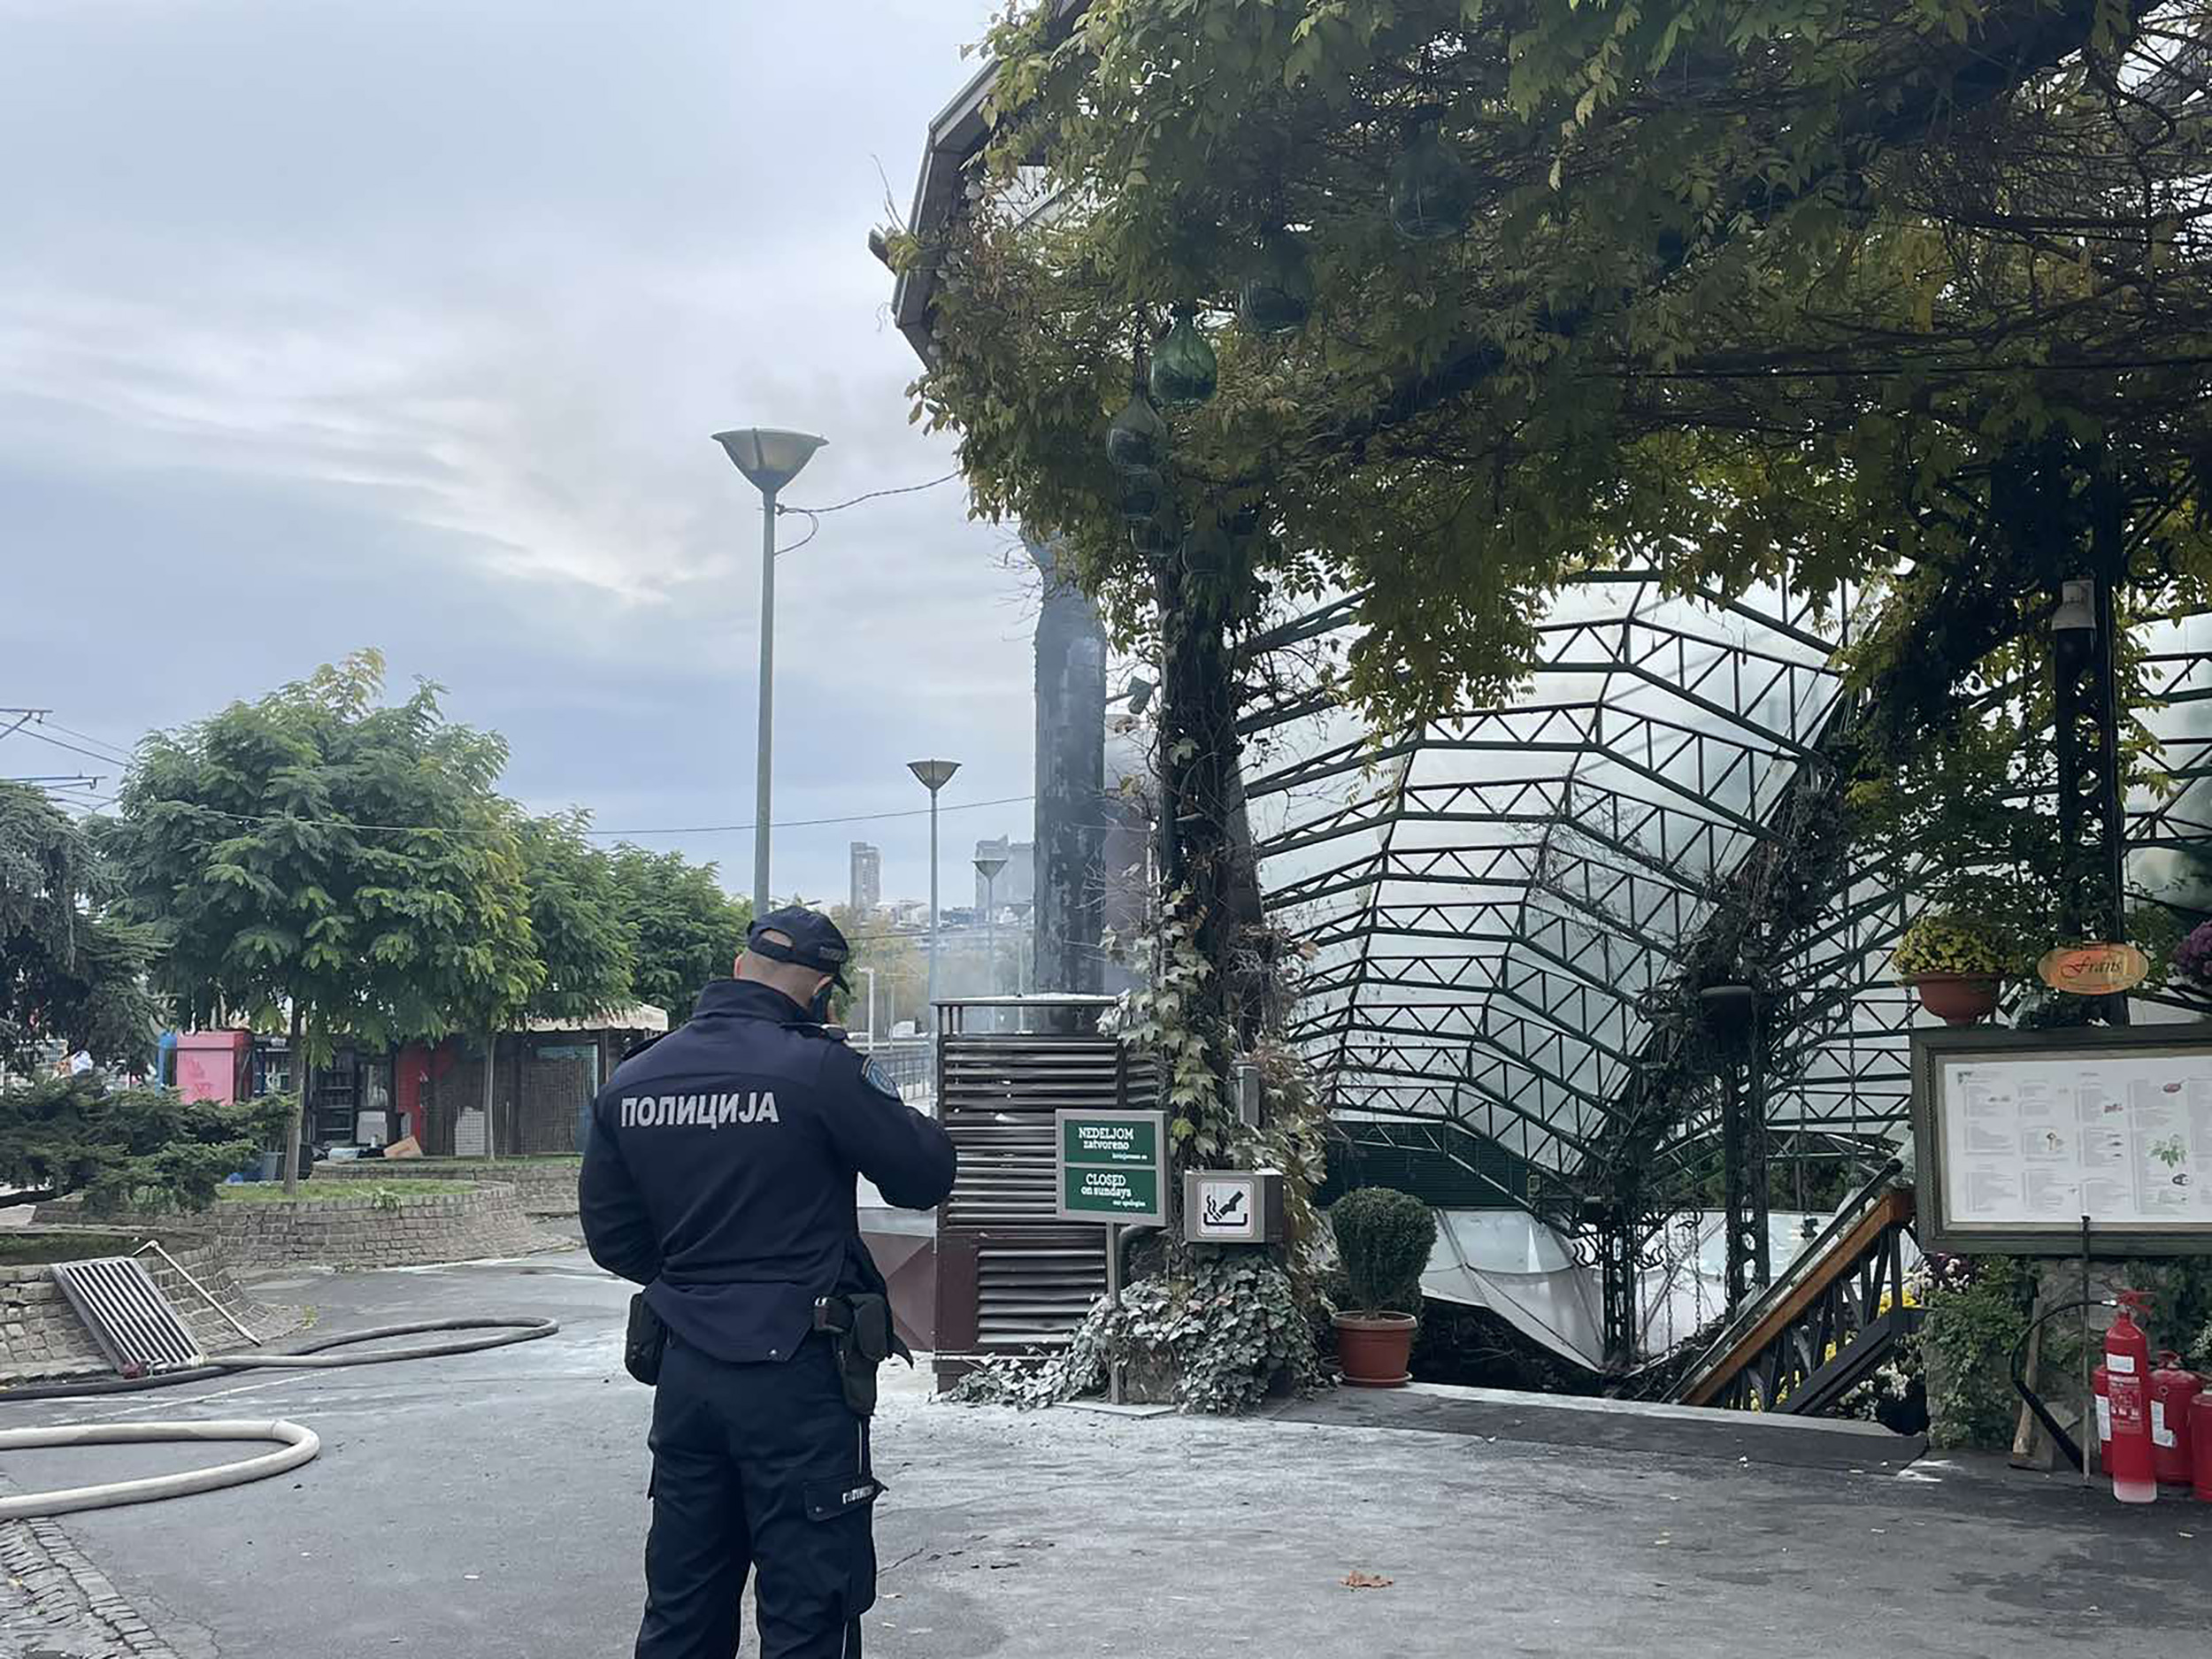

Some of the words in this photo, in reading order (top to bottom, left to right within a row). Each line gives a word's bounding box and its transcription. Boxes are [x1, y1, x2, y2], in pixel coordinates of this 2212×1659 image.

[621, 1092, 780, 1129] ПОЛИЦИЈА
[1079, 1126, 1133, 1140] NEDELJOM
[1083, 1140, 1130, 1150] zatvoreno
[1086, 1173, 1126, 1186] CLOSED
[1080, 1186, 1093, 1195] on
[1094, 1187, 1132, 1200] sundays
